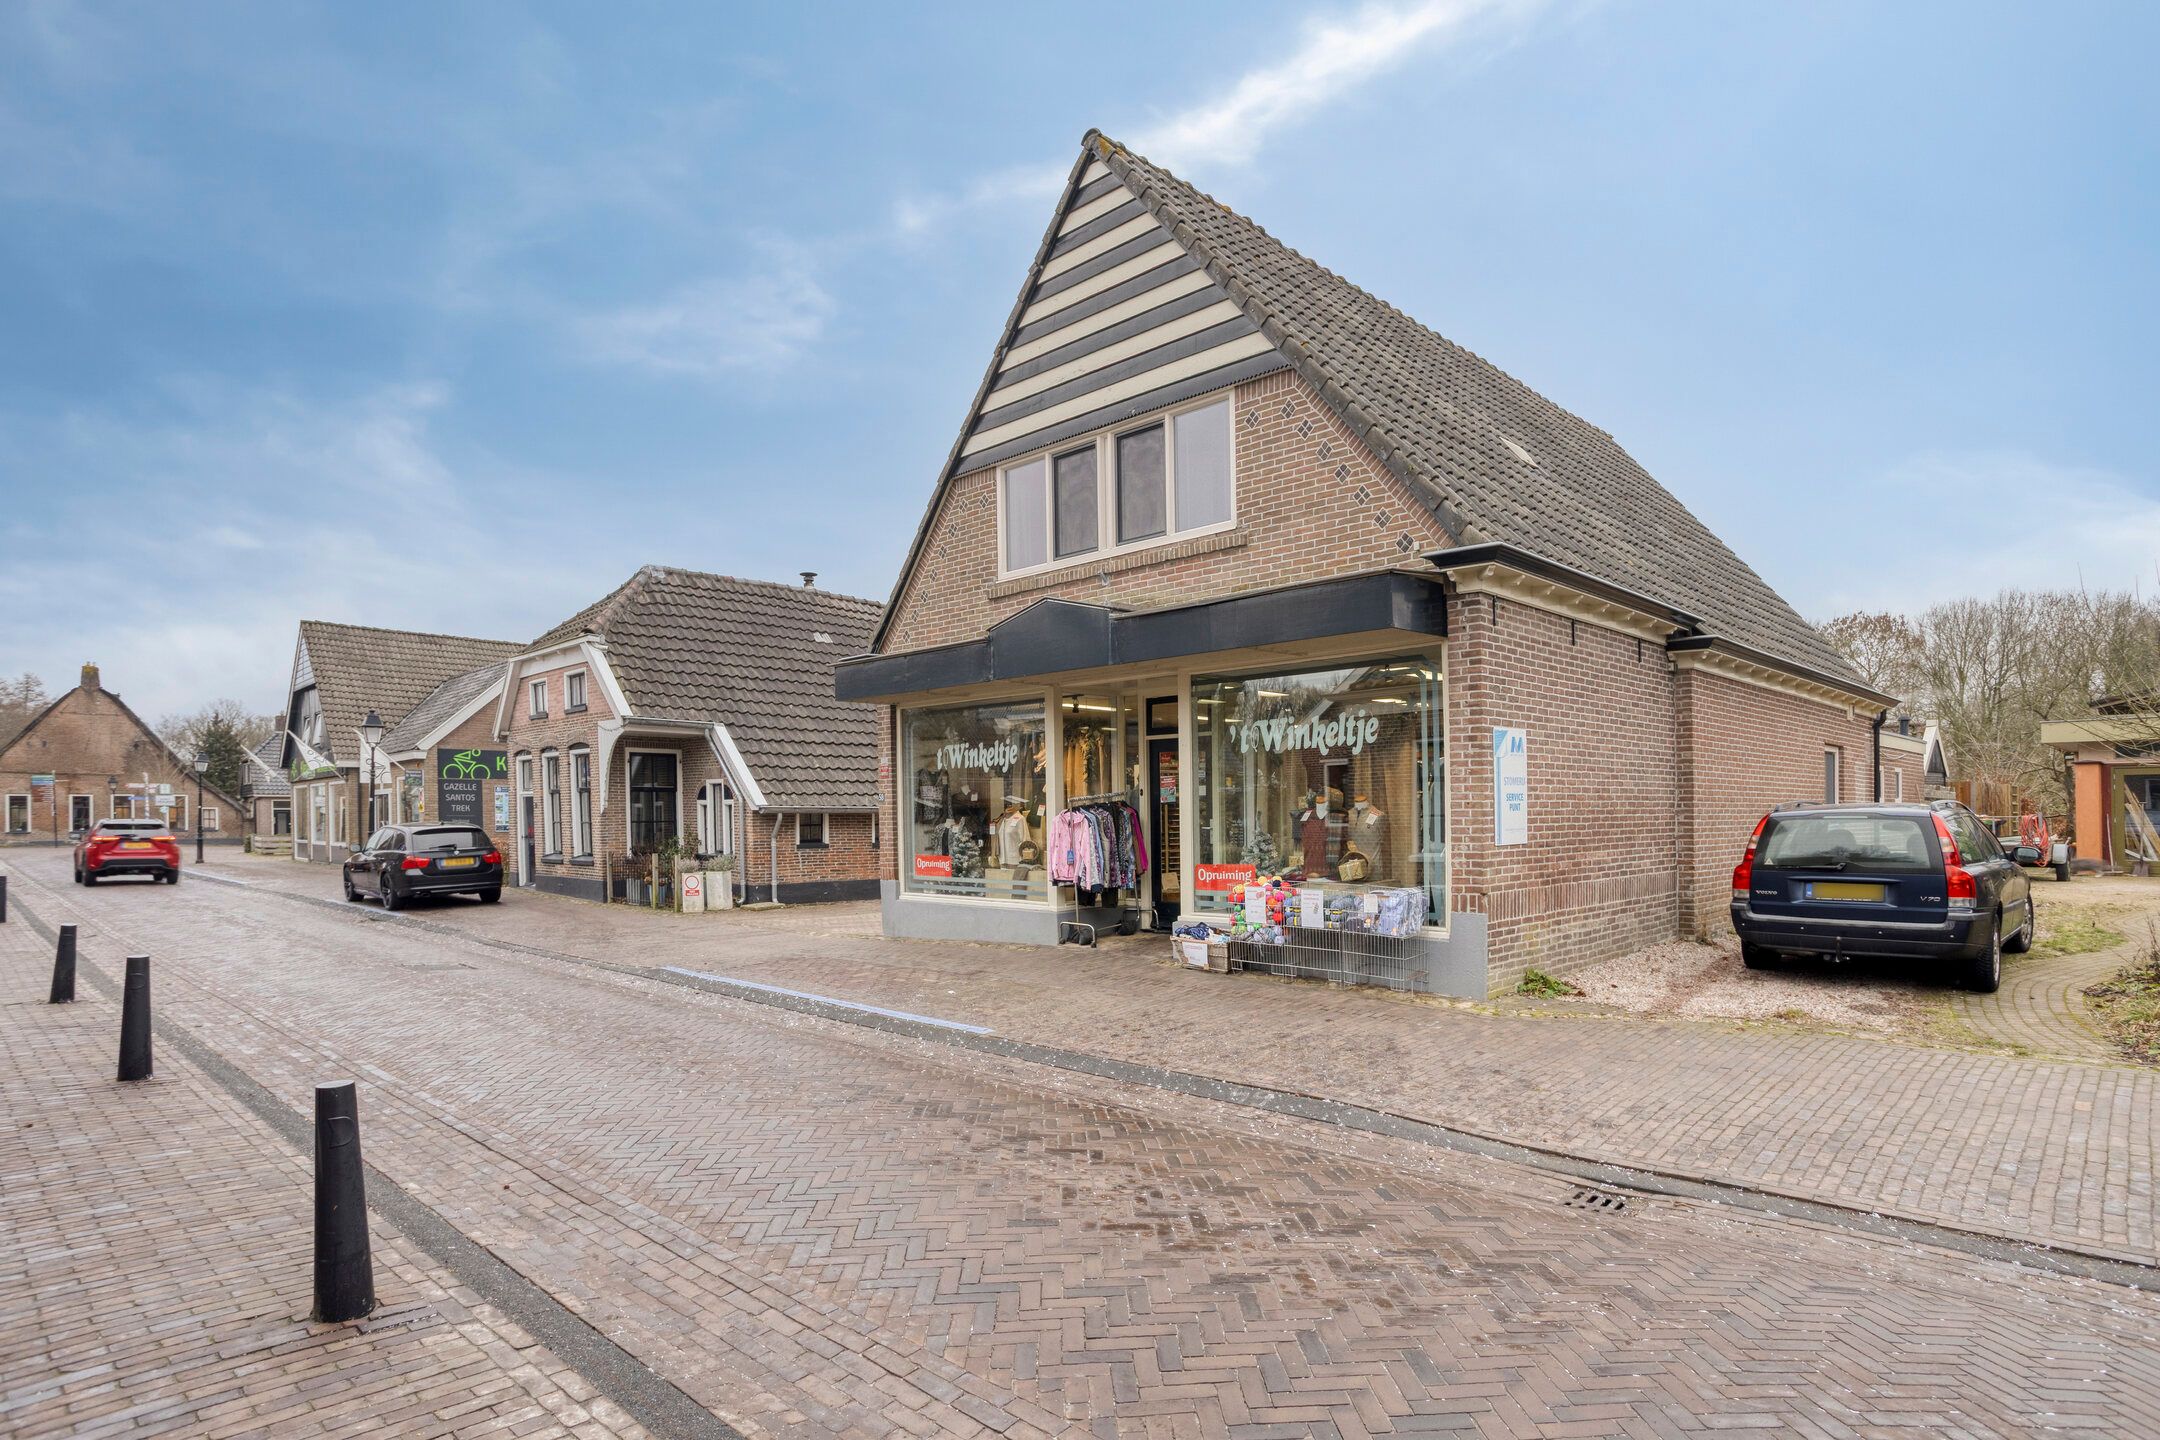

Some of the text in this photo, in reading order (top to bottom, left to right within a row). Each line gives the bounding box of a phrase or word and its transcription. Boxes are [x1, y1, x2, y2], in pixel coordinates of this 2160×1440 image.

[1251, 709, 1379, 756] Winkeltje
[943, 738, 1018, 773] Winkeltje
[443, 783, 477, 791] GAZELLE
[445, 793, 476, 801] SANTOS
[1505, 793, 1524, 802] SERVICE
[451, 804, 471, 812] TREK
[1509, 803, 1521, 812] PUNT
[917, 858, 950, 871] Opruiming
[1198, 868, 1252, 882] Opruiming
